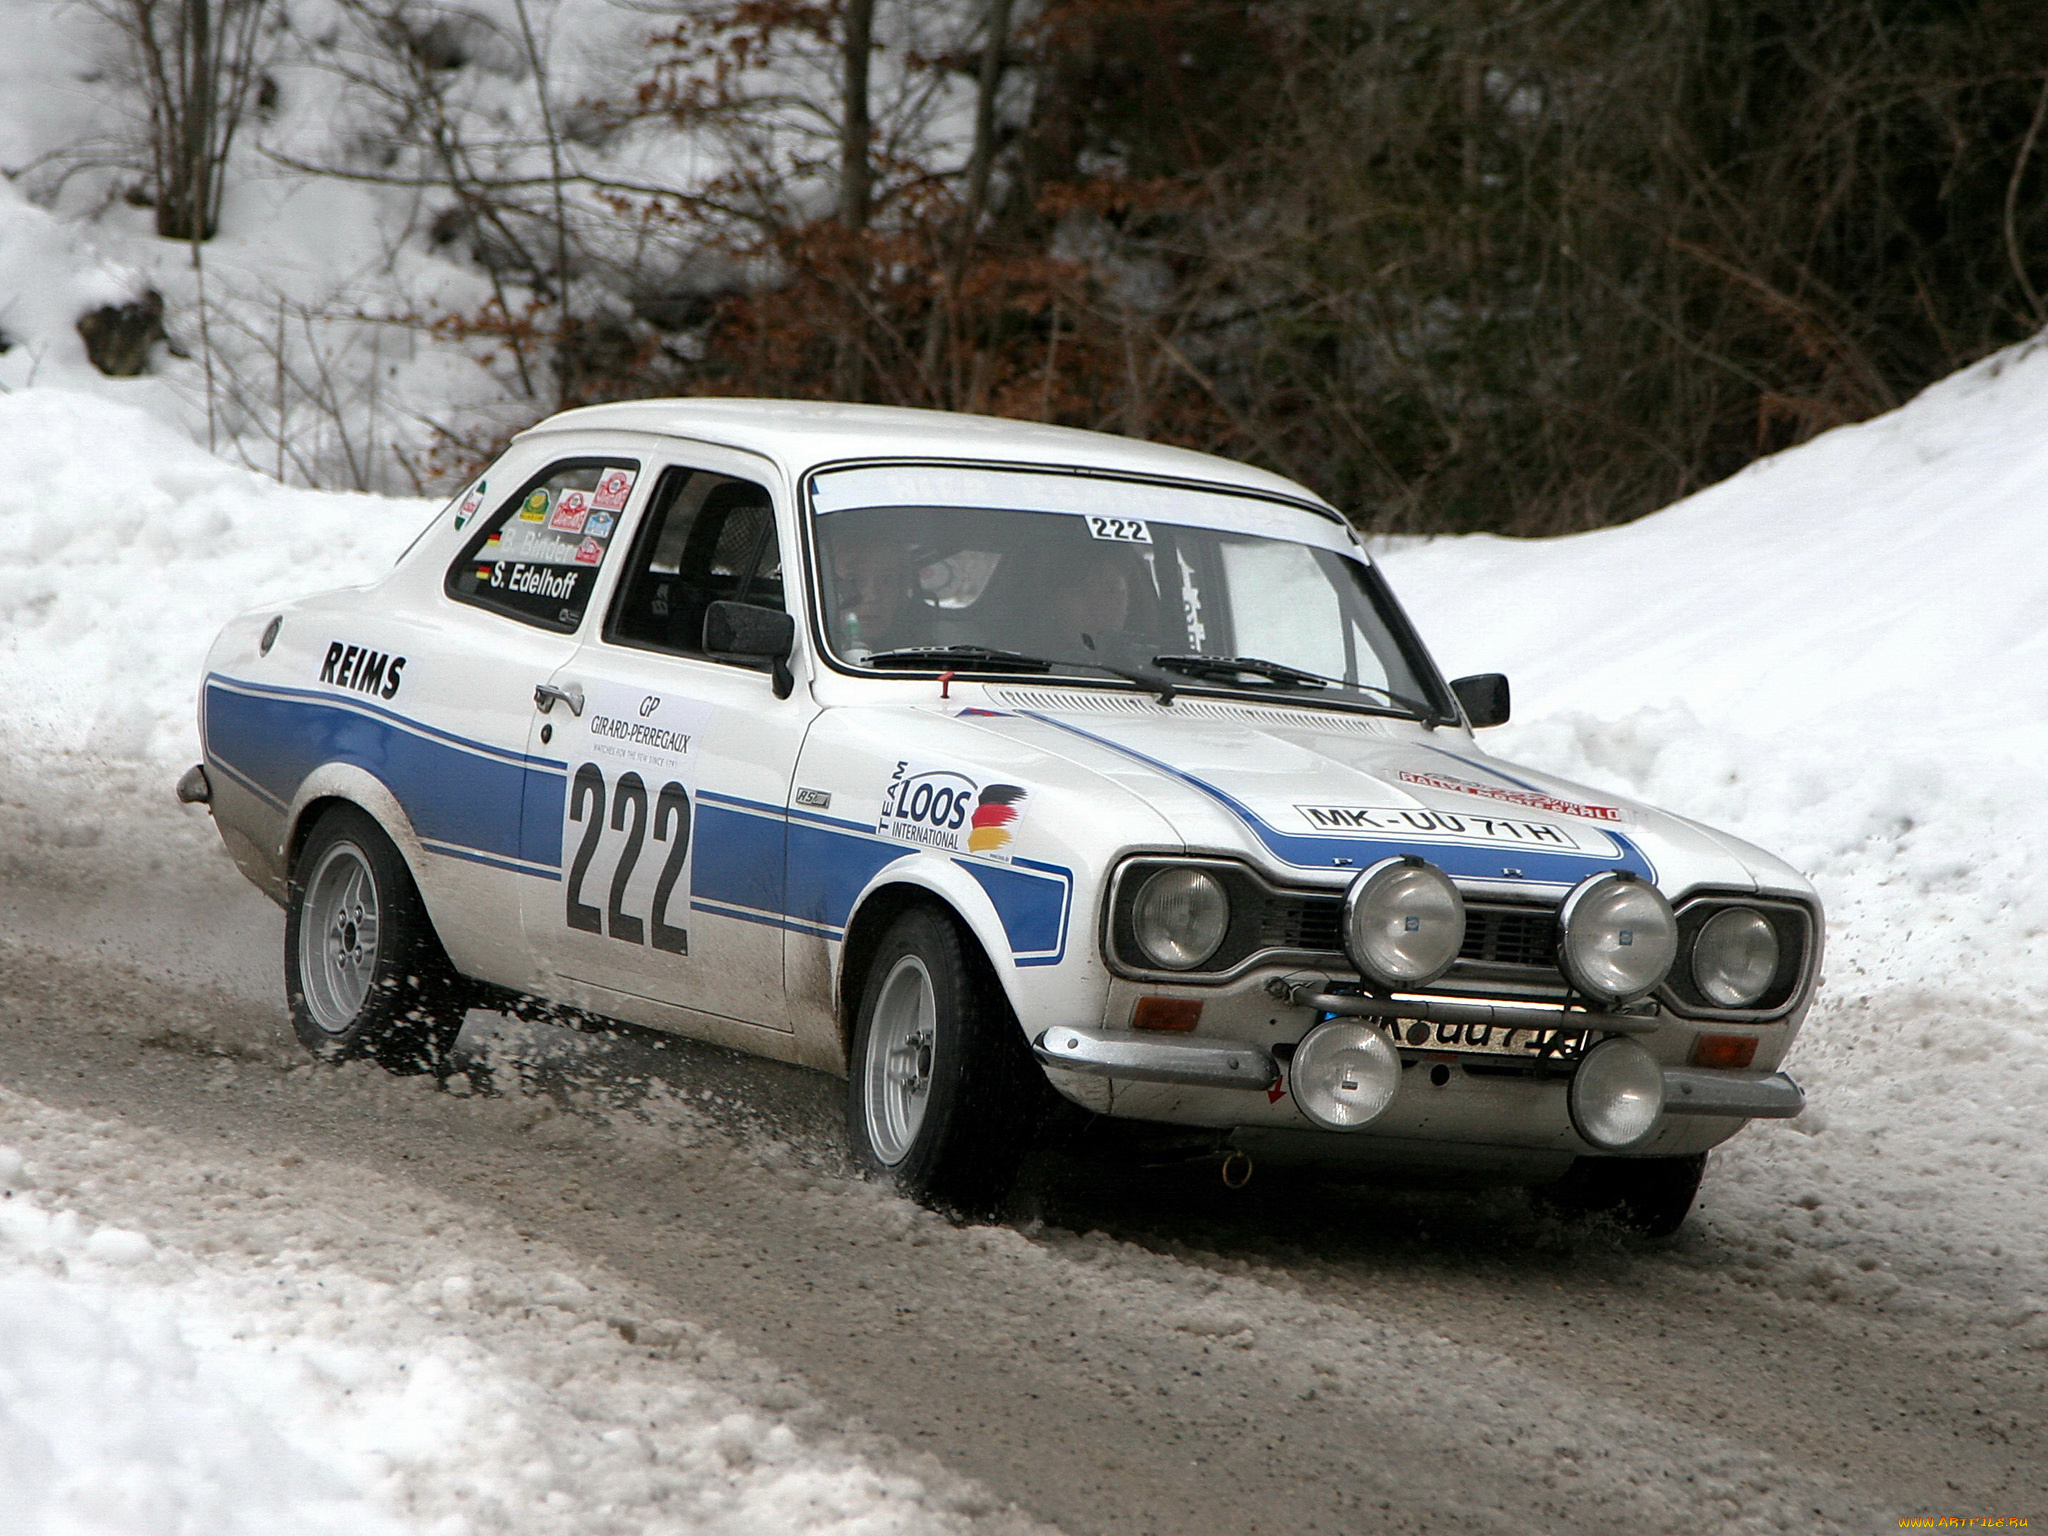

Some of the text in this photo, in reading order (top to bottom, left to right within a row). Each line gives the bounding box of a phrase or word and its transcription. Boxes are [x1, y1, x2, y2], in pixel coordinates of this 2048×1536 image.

[1091, 517, 1147, 541] 222
[490, 560, 579, 600] S. Edelhoff
[319, 641, 406, 700] REIMS
[639, 695, 661, 718] GP
[590, 715, 691, 754] GIRARD-PERREGAUX
[878, 761, 908, 833] TEAM
[896, 779, 972, 830] LOOS
[892, 821, 959, 850] INTERNATIONAL
[566, 762, 691, 956] 222
